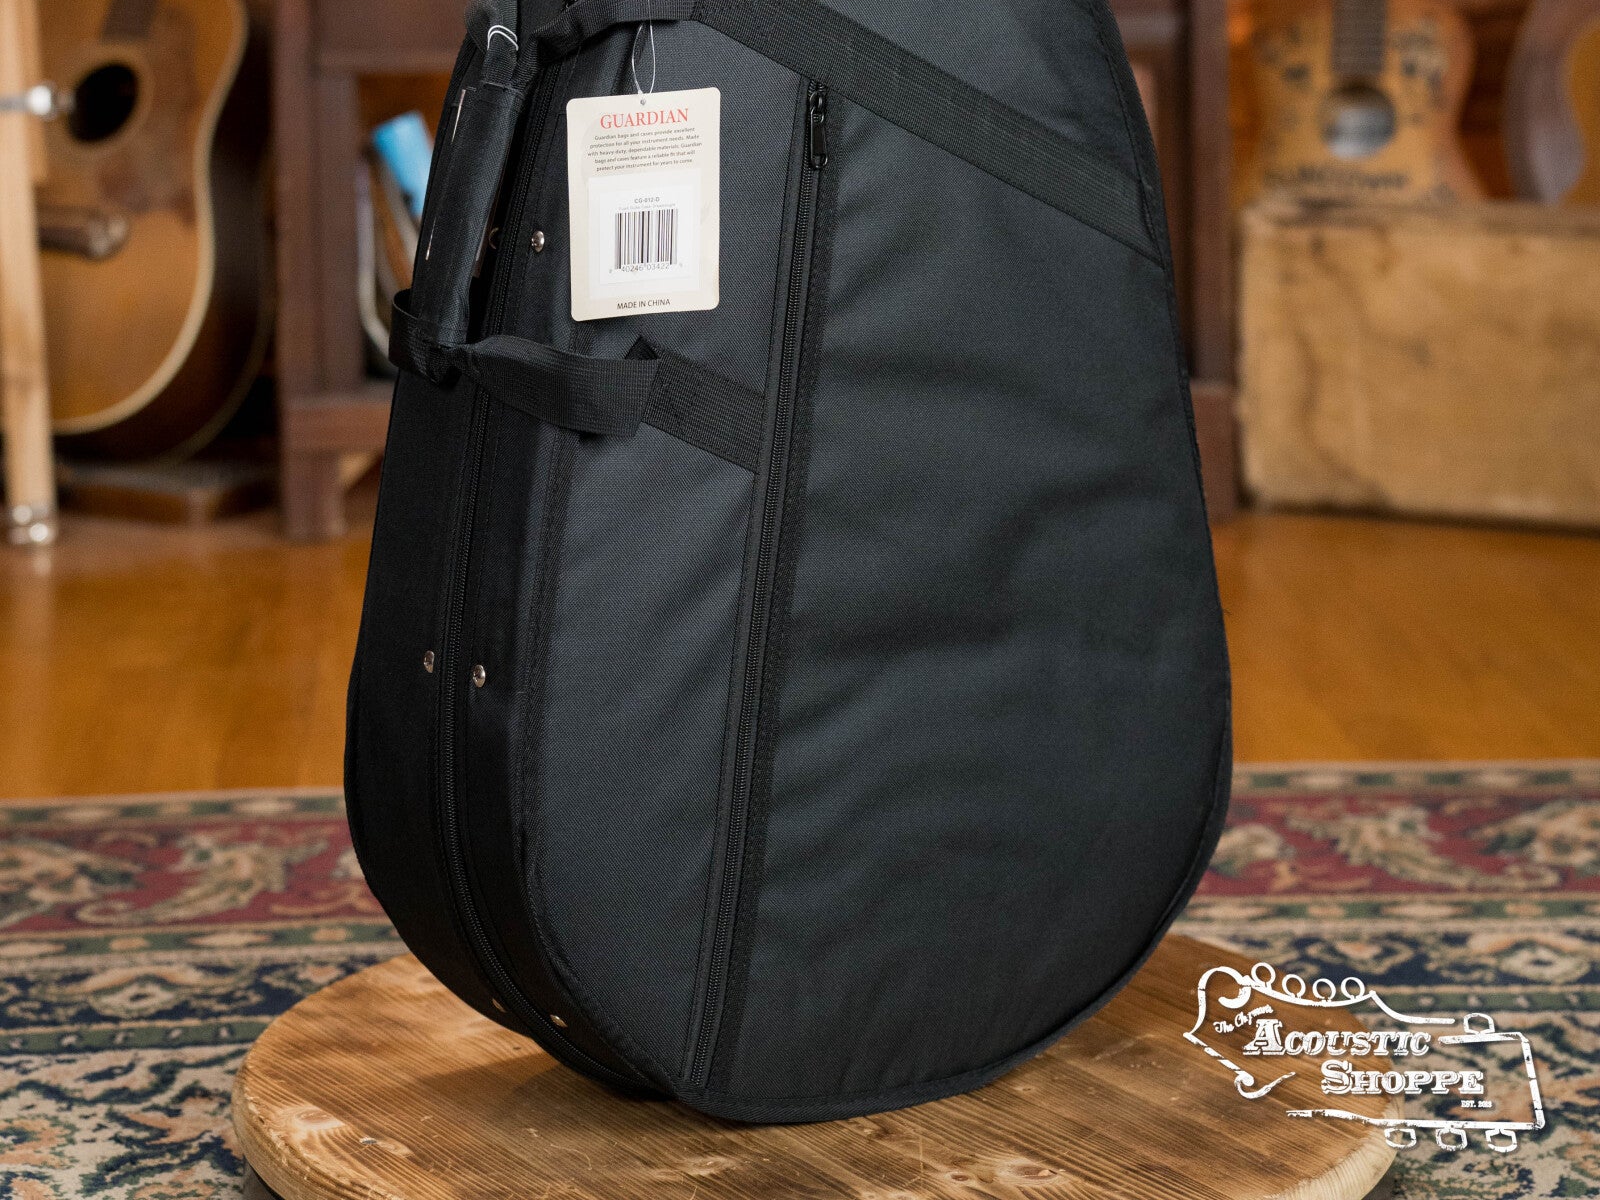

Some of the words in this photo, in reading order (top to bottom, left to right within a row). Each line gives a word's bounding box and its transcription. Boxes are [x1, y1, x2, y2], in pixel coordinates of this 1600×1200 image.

[600, 108, 689, 129] GUARDIAN
[621, 264, 644, 273] 40246
[617, 301, 638, 310] MADE
[639, 300, 646, 308] IN
[648, 298, 671, 307] CHINA
